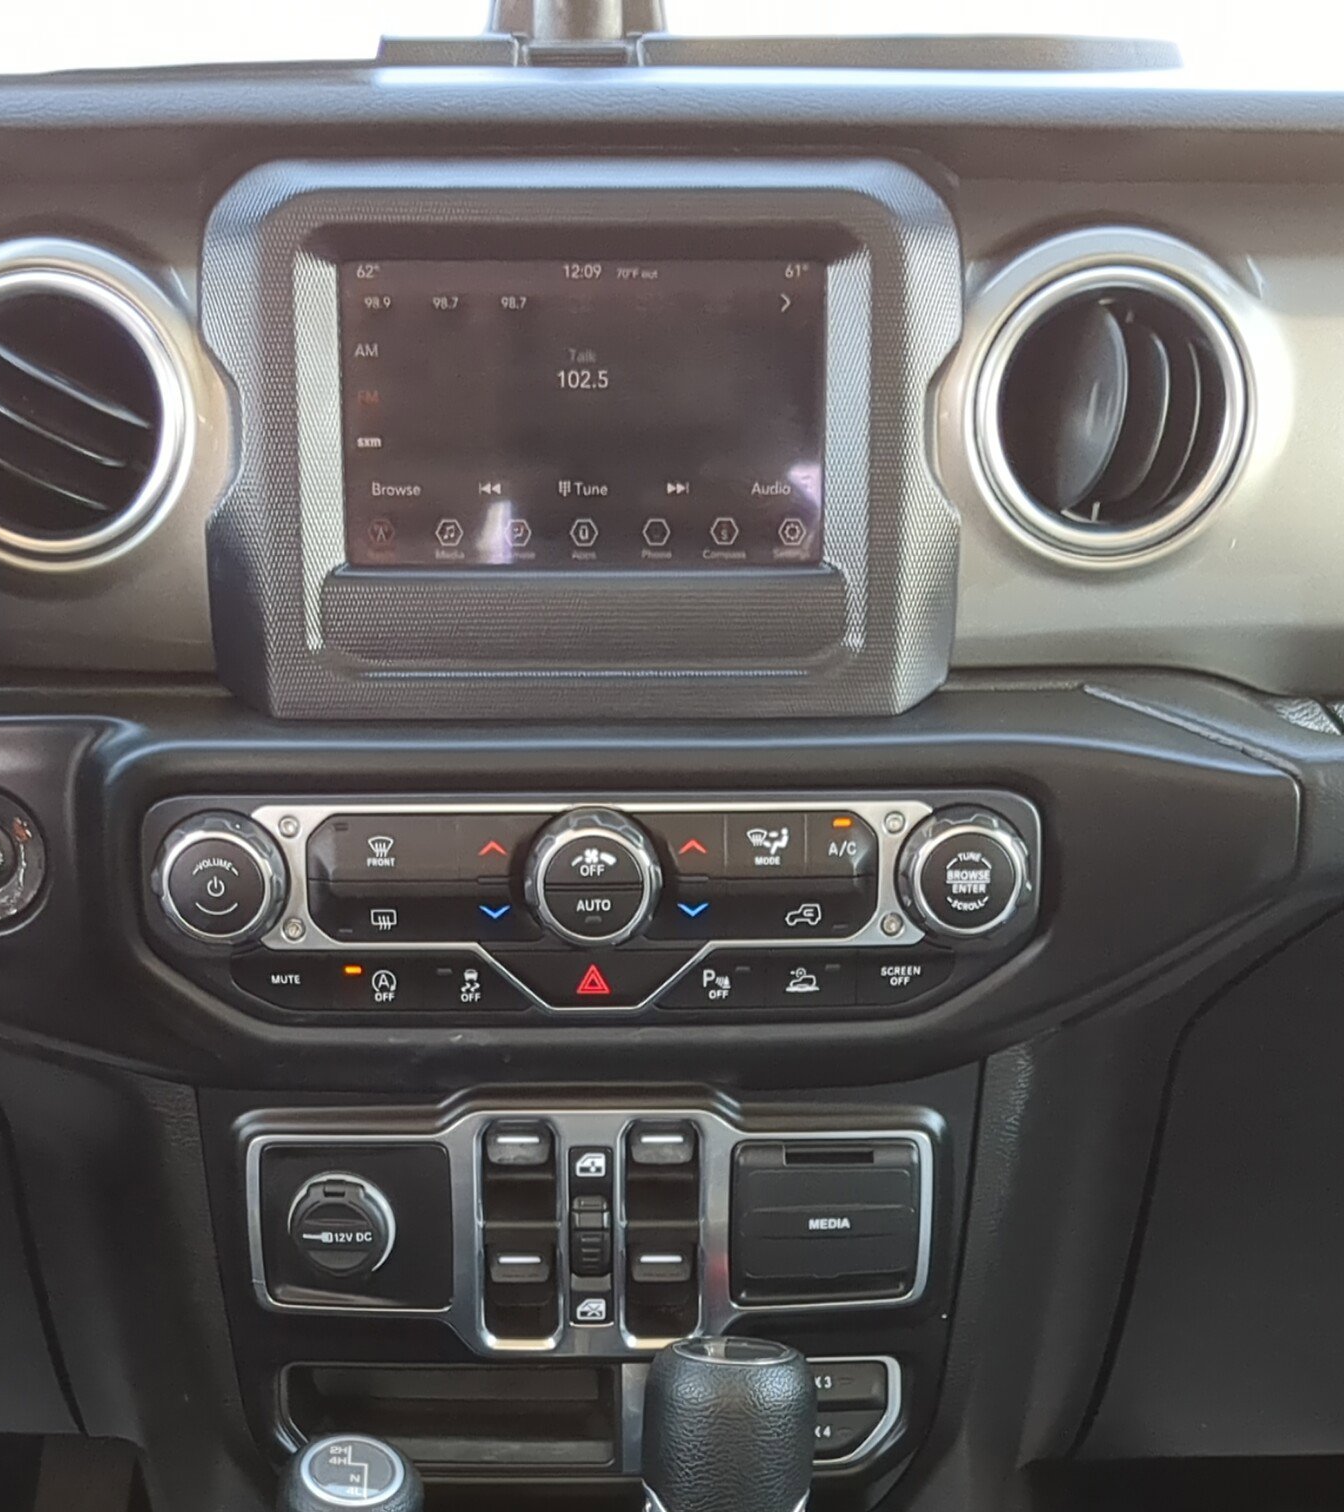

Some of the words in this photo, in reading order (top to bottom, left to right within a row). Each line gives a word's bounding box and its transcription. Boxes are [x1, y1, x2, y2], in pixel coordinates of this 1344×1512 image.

[562, 263, 602, 279] 12:09
[364, 296, 391, 309] 98.9
[432, 296, 458, 309] 98.7
[500, 296, 527, 309] 98.7
[354, 343, 379, 358] AM
[569, 349, 597, 363] Talk
[557, 370, 609, 389] 102.5
[357, 436, 382, 448] sxm
[371, 481, 422, 497] Browse
[574, 482, 608, 497] Tune
[751, 481, 791, 496] Audio
[828, 840, 857, 857] A/C
[366, 857, 396, 868] FRONT
[754, 856, 781, 866] MODE
[957, 851, 982, 862] TUNE
[197, 858, 233, 871] VOLUME
[580, 864, 606, 877] OFF
[946, 870, 991, 880] BROWSE
[952, 884, 986, 894] ENTER
[576, 898, 612, 912] AUTO
[951, 899, 985, 911] SCROLL
[880, 965, 921, 977] SCREEN
[270, 974, 301, 985] MUTE
[889, 976, 911, 986] OFF
[374, 992, 395, 1002] OFF
[460, 992, 481, 1003] OFF
[708, 989, 729, 1000] OFF
[808, 1217, 851, 1231] MEDIA
[334, 1232, 353, 1243] 12V
[356, 1231, 373, 1243] DC
[328, 1456, 347, 1466] 4H
[350, 1474, 361, 1483] N
